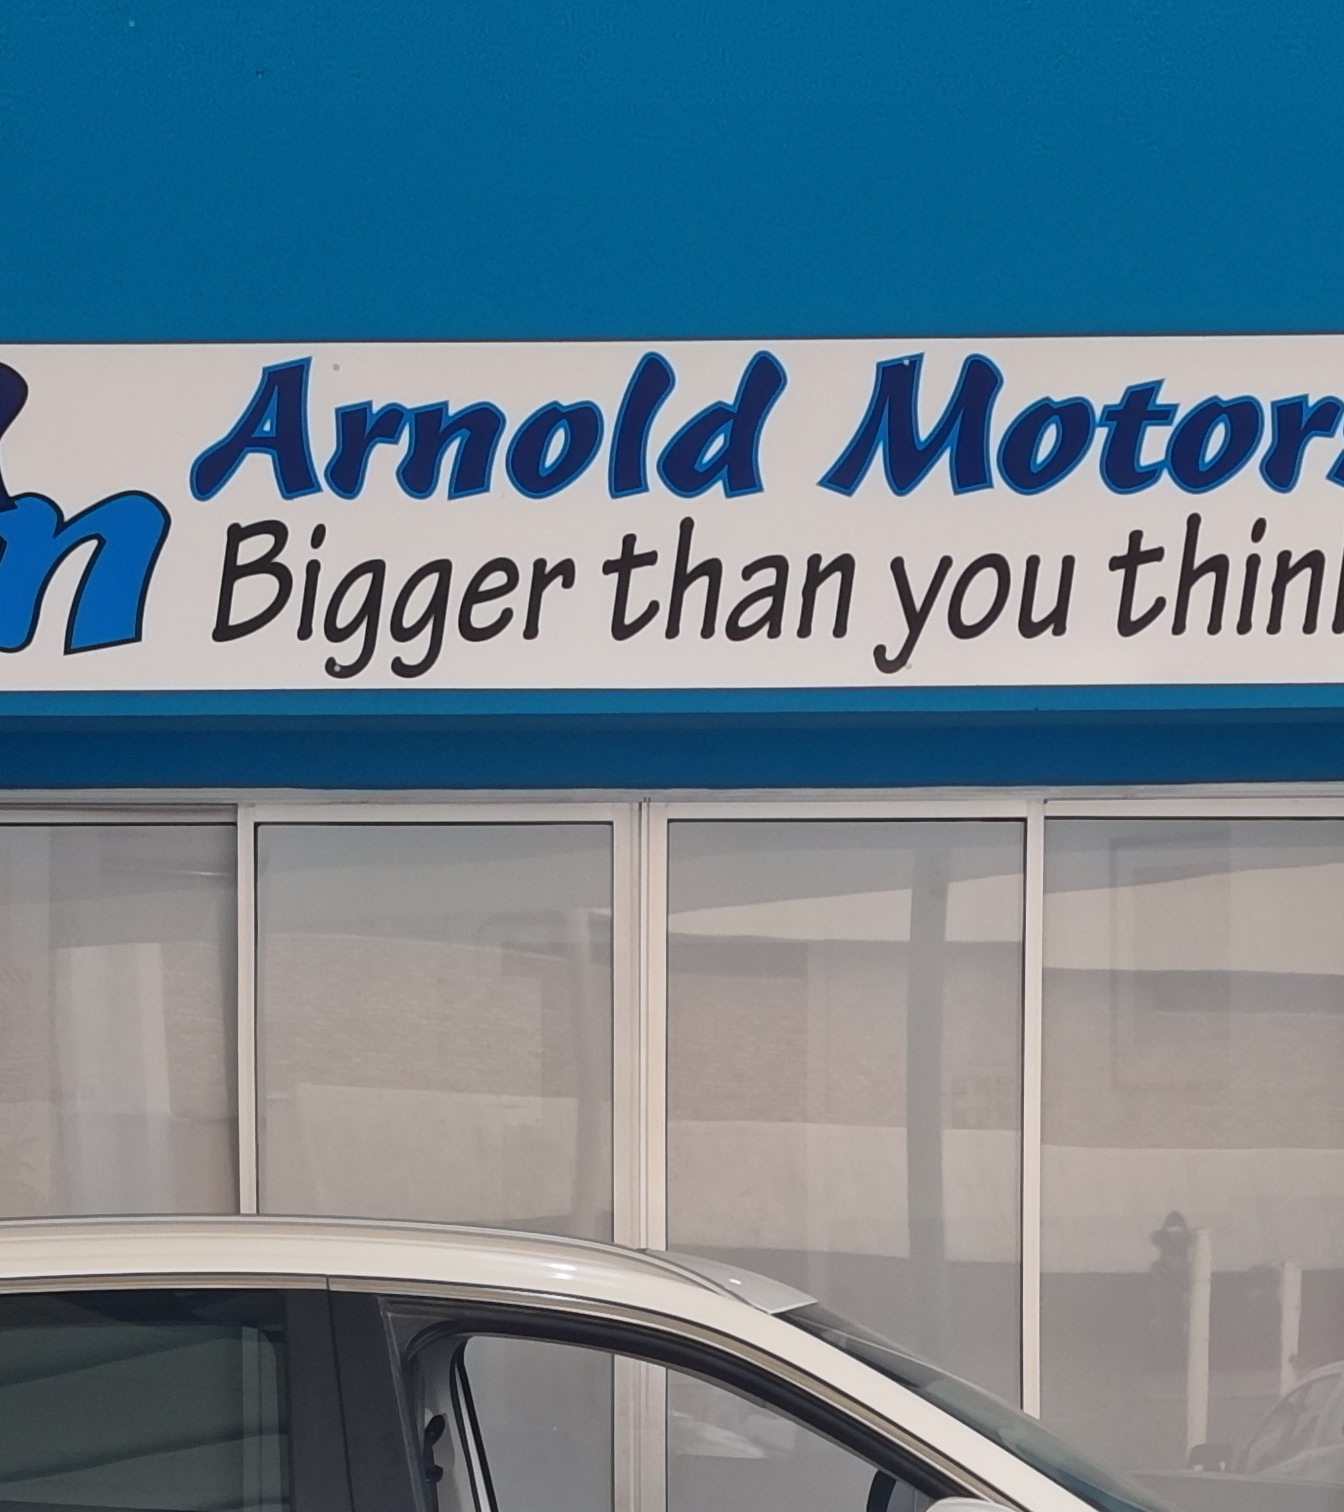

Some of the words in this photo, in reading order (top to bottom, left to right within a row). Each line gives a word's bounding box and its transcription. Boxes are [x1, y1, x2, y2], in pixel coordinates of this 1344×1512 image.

[189, 350, 787, 502] Arnold
[212, 519, 575, 678] Bigger
[602, 516, 856, 641] than
[873, 553, 1075, 674] you
